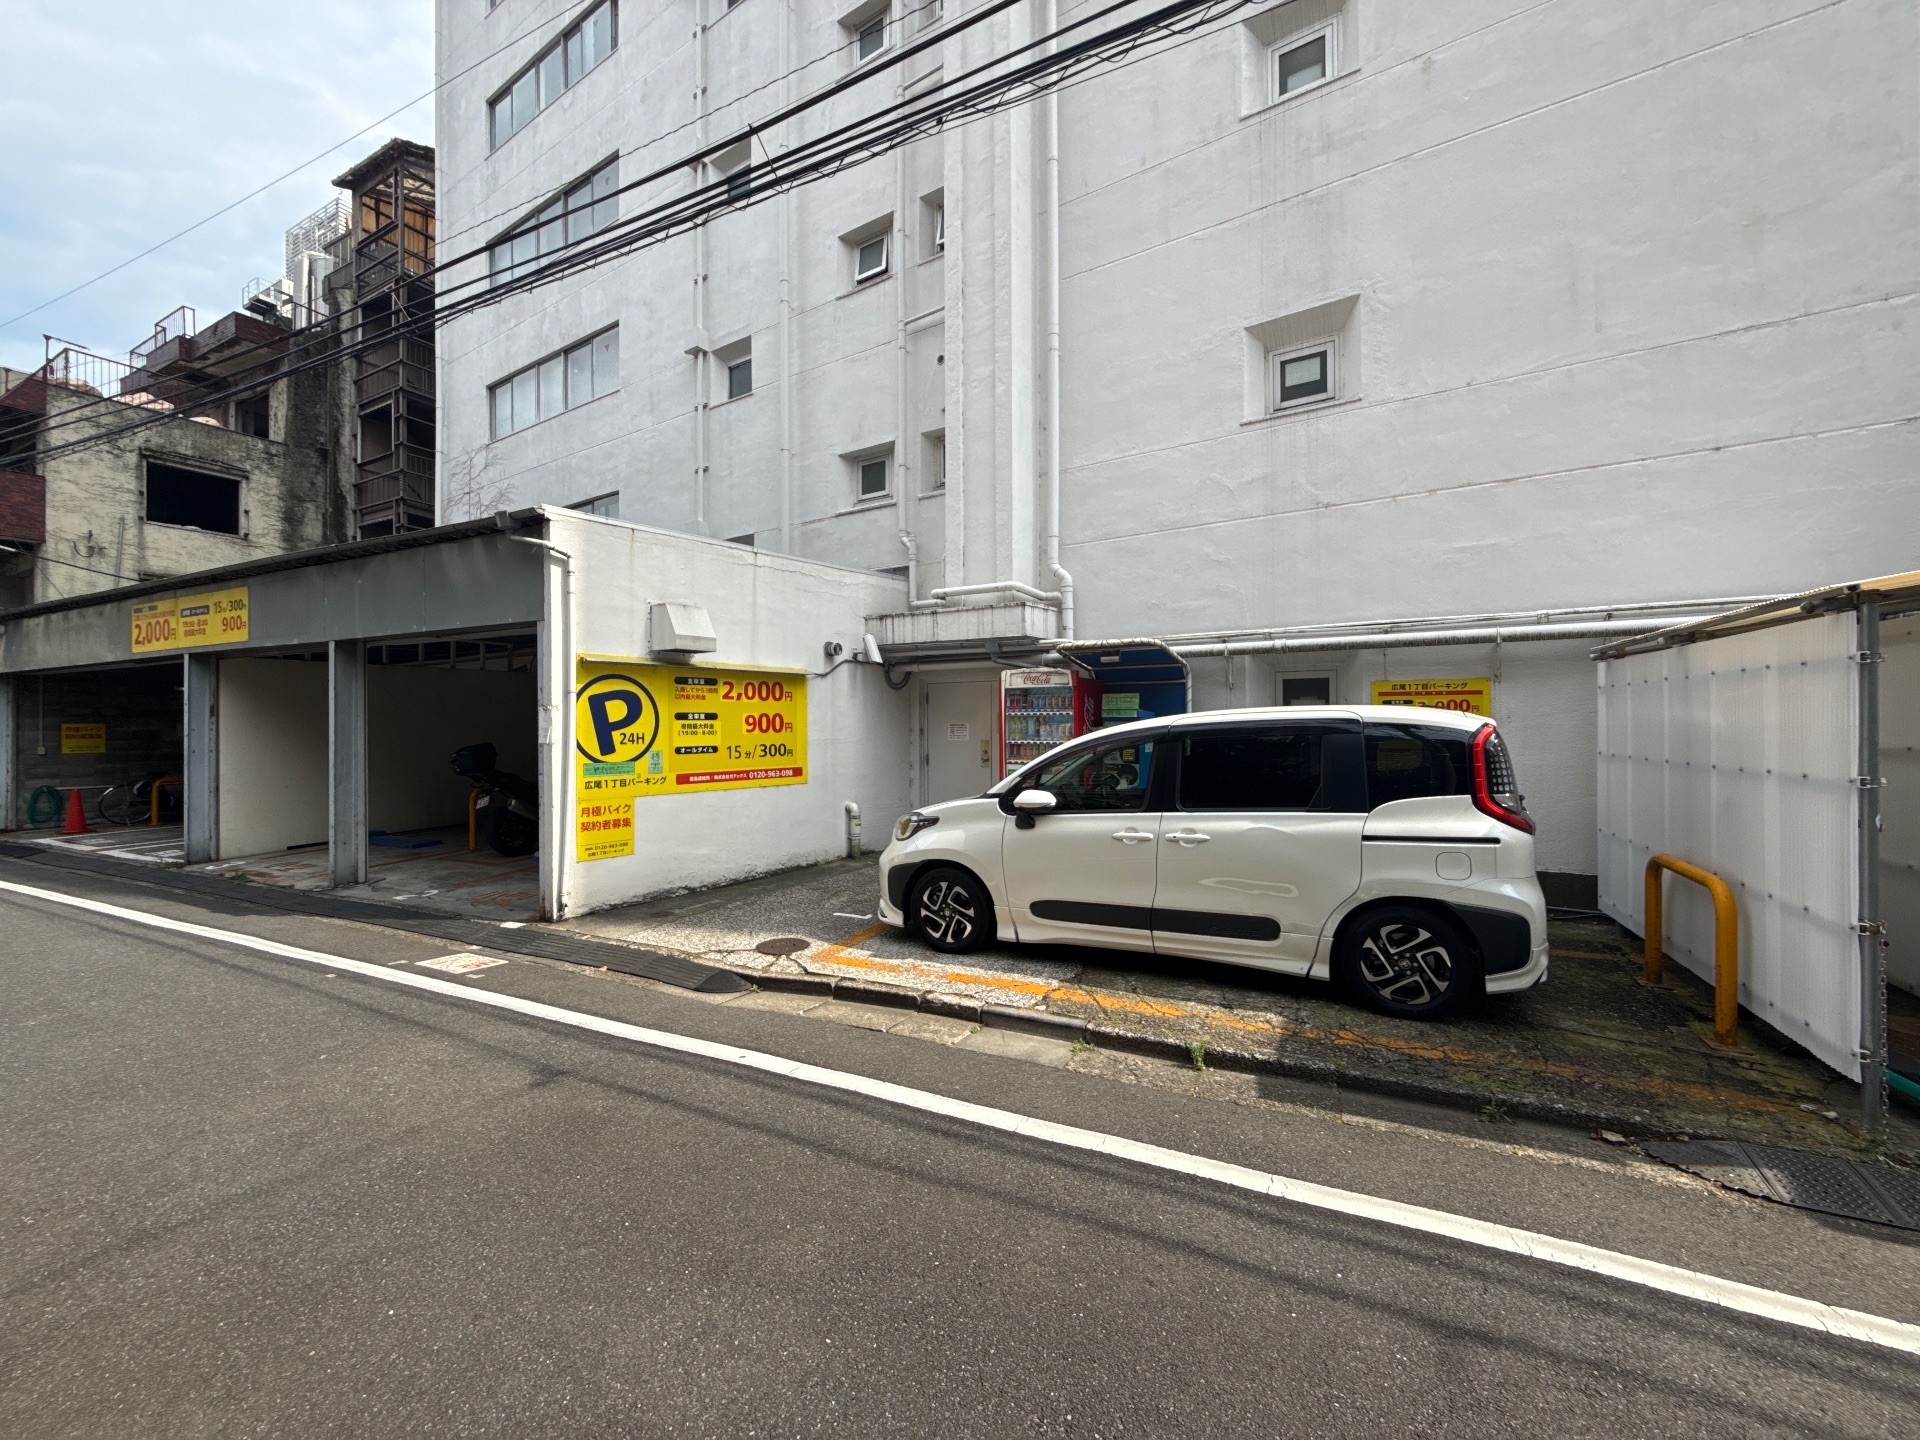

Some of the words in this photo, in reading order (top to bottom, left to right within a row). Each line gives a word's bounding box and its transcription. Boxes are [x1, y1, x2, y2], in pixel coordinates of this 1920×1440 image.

[721, 680, 793, 702] 2,000円
[588, 690, 643, 757] P
[744, 712, 793, 734] 900円
[619, 732, 646, 745] 24H
[680, 746, 714, 754] オールタイム
[748, 769, 794, 780] 0120-963-098
[584, 776, 667, 790] 広尾1丁目パーキング
[580, 804, 632, 818] 月極バイク
[580, 818, 632, 833] 契約者募集
